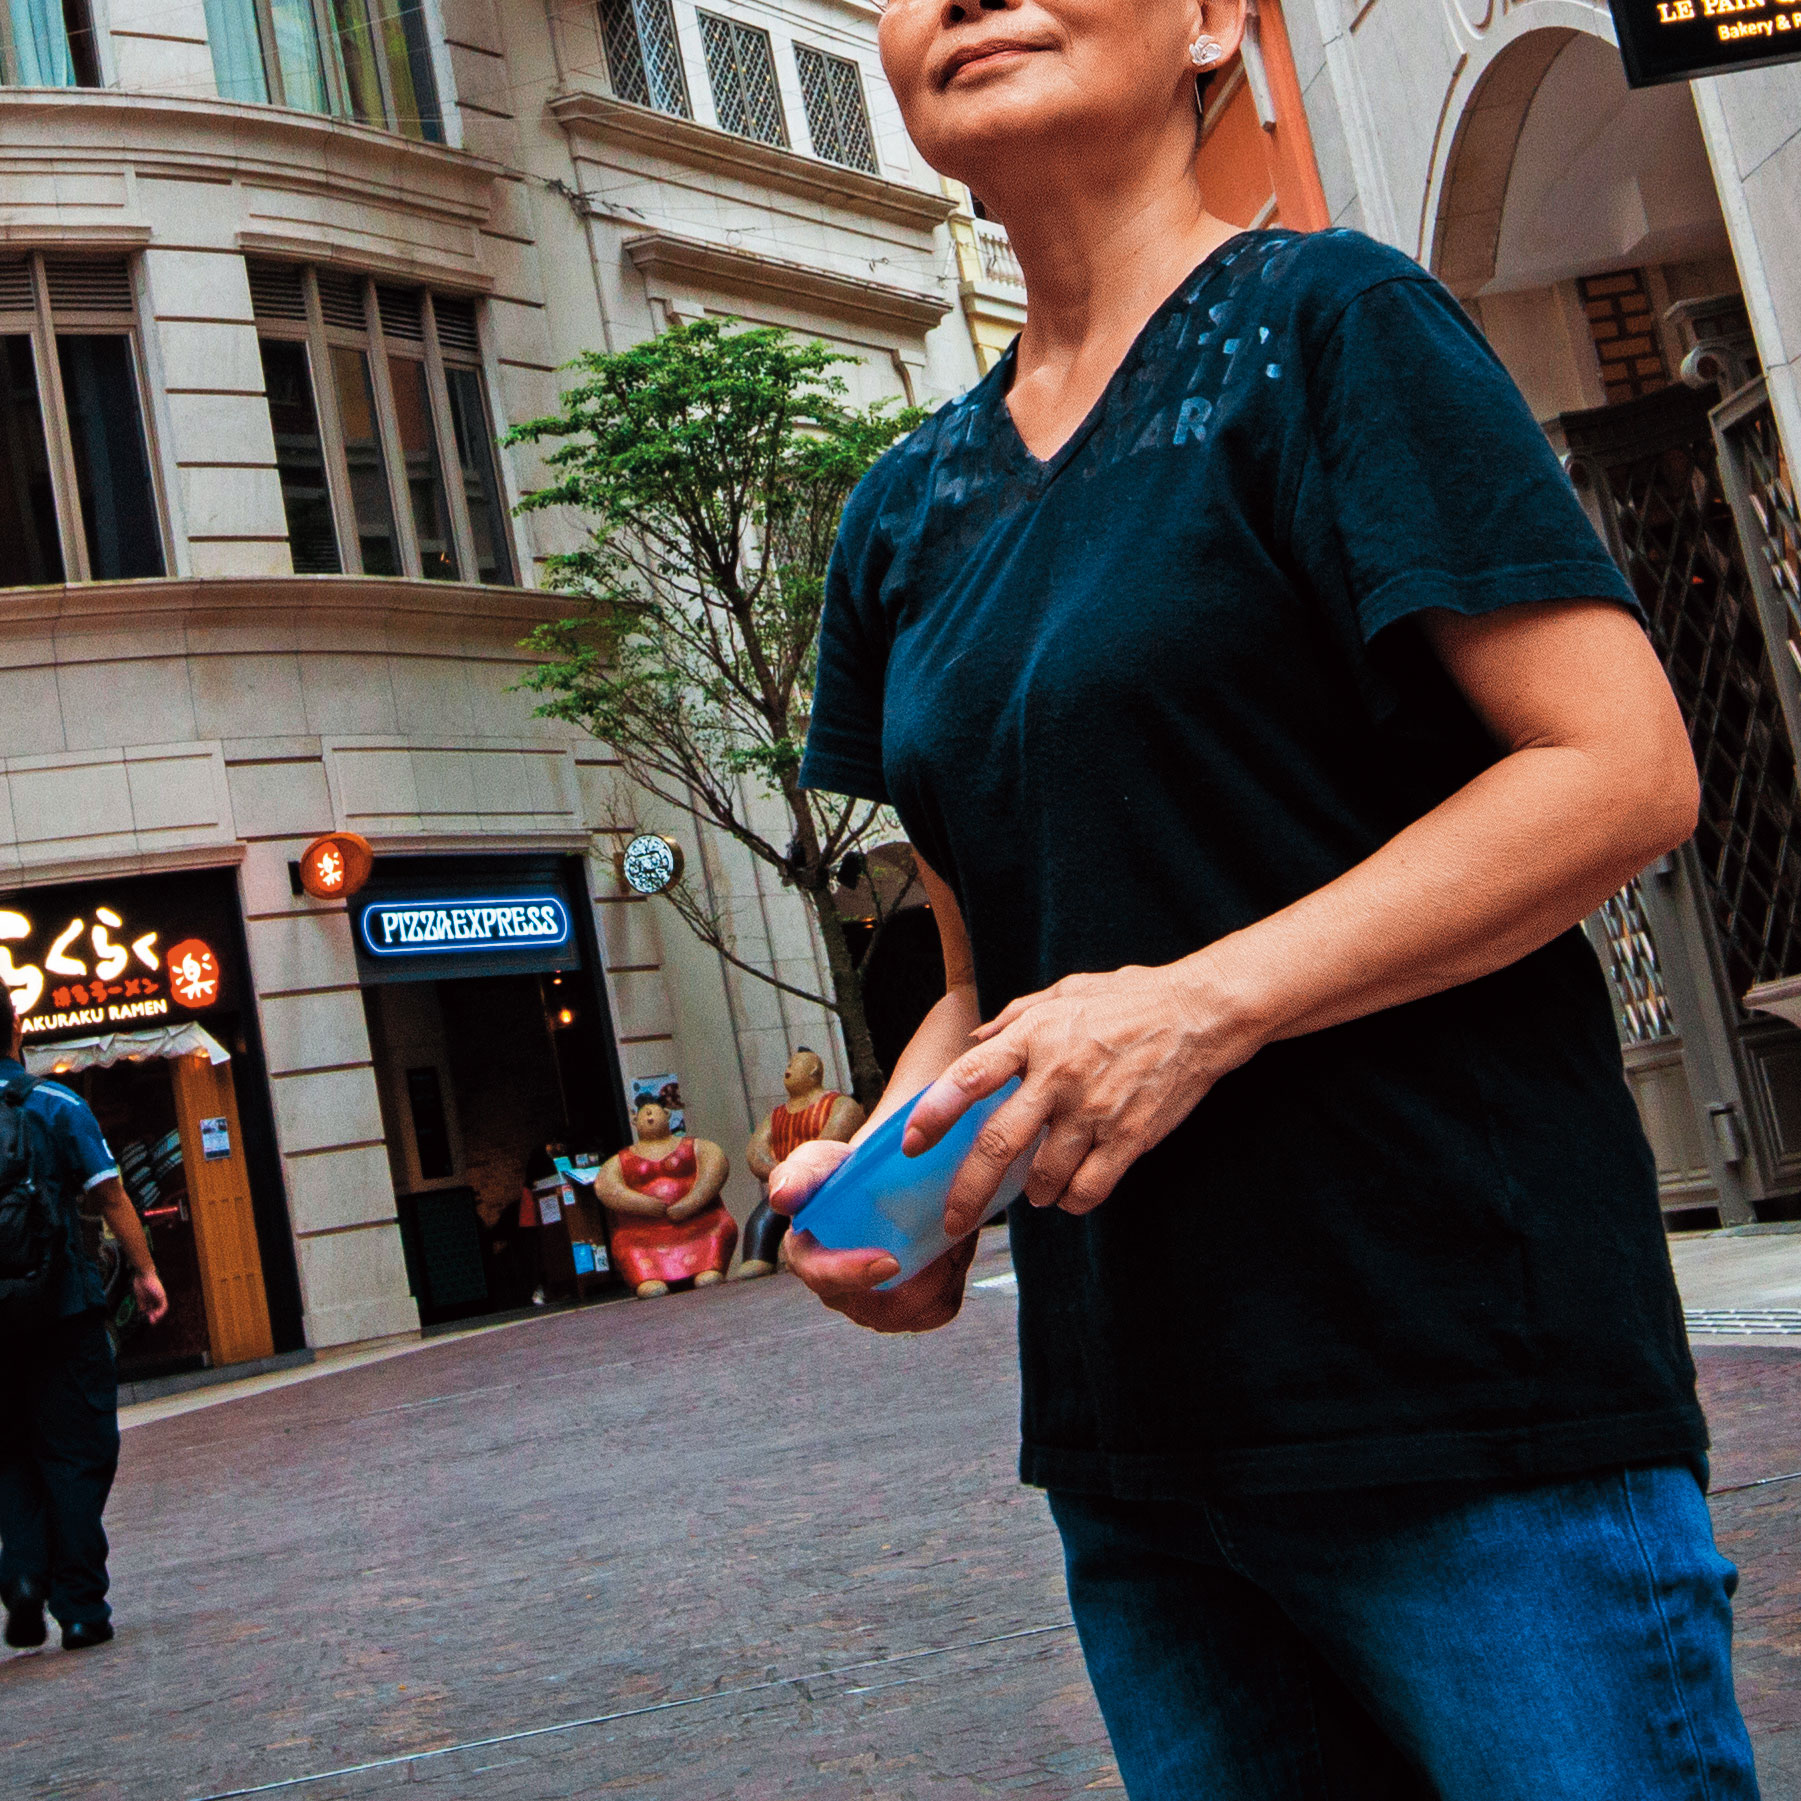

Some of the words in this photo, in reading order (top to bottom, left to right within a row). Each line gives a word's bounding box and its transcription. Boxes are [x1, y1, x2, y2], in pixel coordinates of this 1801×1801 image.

[1657, 0, 1695, 23] LE
[1718, 20, 1773, 41] Bakery
[1776, 14, 1791, 32] &
[381, 906, 559, 943] PIZZAEXPRESS
[171, 952, 216, 1000] 楽
[21, 1007, 105, 1034] AKURAKU
[107, 998, 168, 1021] RAMEN
